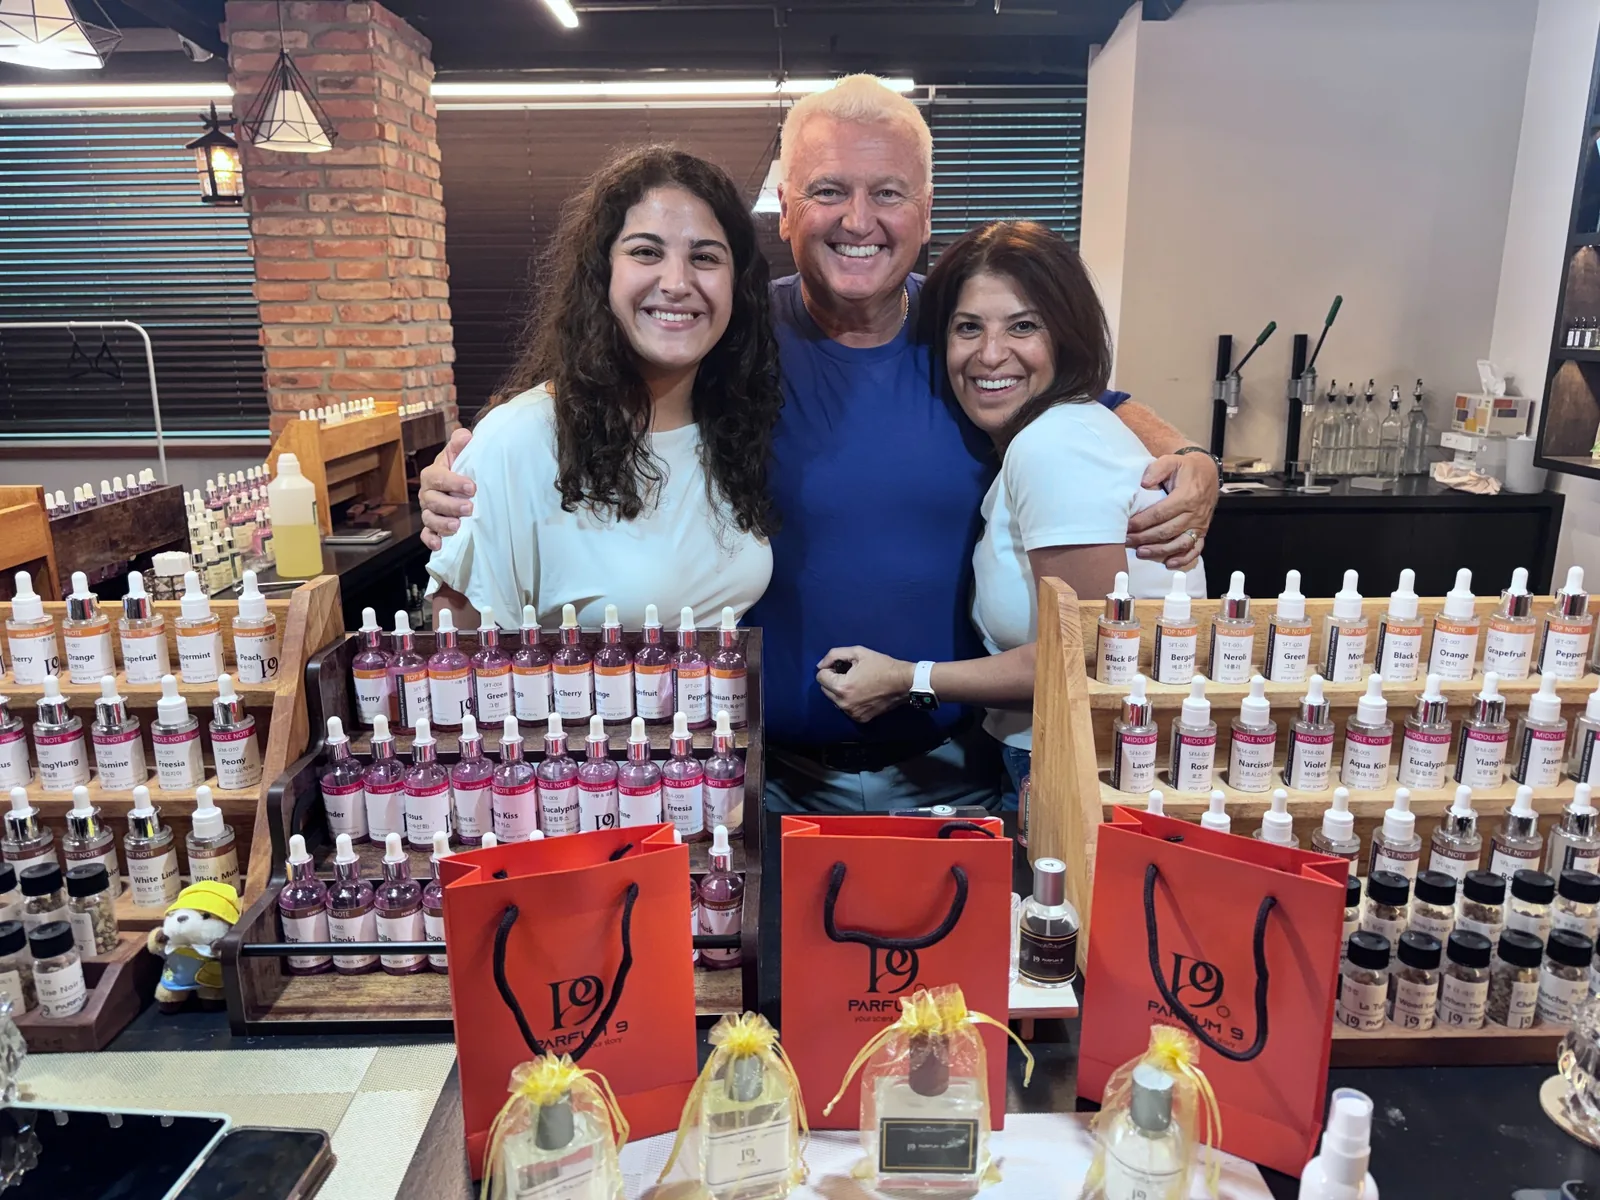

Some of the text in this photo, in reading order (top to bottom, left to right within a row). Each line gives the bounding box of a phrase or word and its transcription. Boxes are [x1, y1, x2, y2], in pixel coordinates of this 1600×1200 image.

[1449, 626, 1466, 634] NOTE
[1494, 624, 1509, 632] NOTE
[180, 652, 211, 661] permint
[1393, 651, 1414, 660] Black
[1439, 649, 1469, 660] Orange
[1488, 646, 1527, 658] Grapefruit
[68, 653, 95, 663] Orange
[123, 653, 157, 664] rapefruit
[1105, 654, 1126, 663] Black
[1223, 653, 1247, 661] Neroli
[487, 692, 508, 700] Green
[559, 690, 582, 698] Cherry
[231, 729, 250, 738] NOTE
[1470, 731, 1494, 741] MIDDLE
[169, 735, 187, 743] NOTE
[1297, 735, 1321, 743] MIDDLE
[1429, 735, 1446, 743] NOTE
[40, 758, 79, 770] angYlang
[221, 757, 247, 766] Peony
[1190, 762, 1209, 770] Rose
[1303, 760, 1326, 769] Violet
[1349, 759, 1371, 770] Aqua
[554, 780, 571, 788] NOTE
[681, 779, 696, 787] NOTE
[667, 804, 693, 812] Freesia
[503, 812, 519, 820] Kiss
[1496, 844, 1512, 854] LAST
[80, 850, 98, 858] NOTE
[136, 850, 154, 858] NOTE
[1447, 850, 1466, 859] NOTE
[134, 875, 159, 884] White
[848, 1000, 903, 1012] PARFU
[1148, 1000, 1244, 1040] PARUM 9
[616, 1020, 629, 1033] 9
